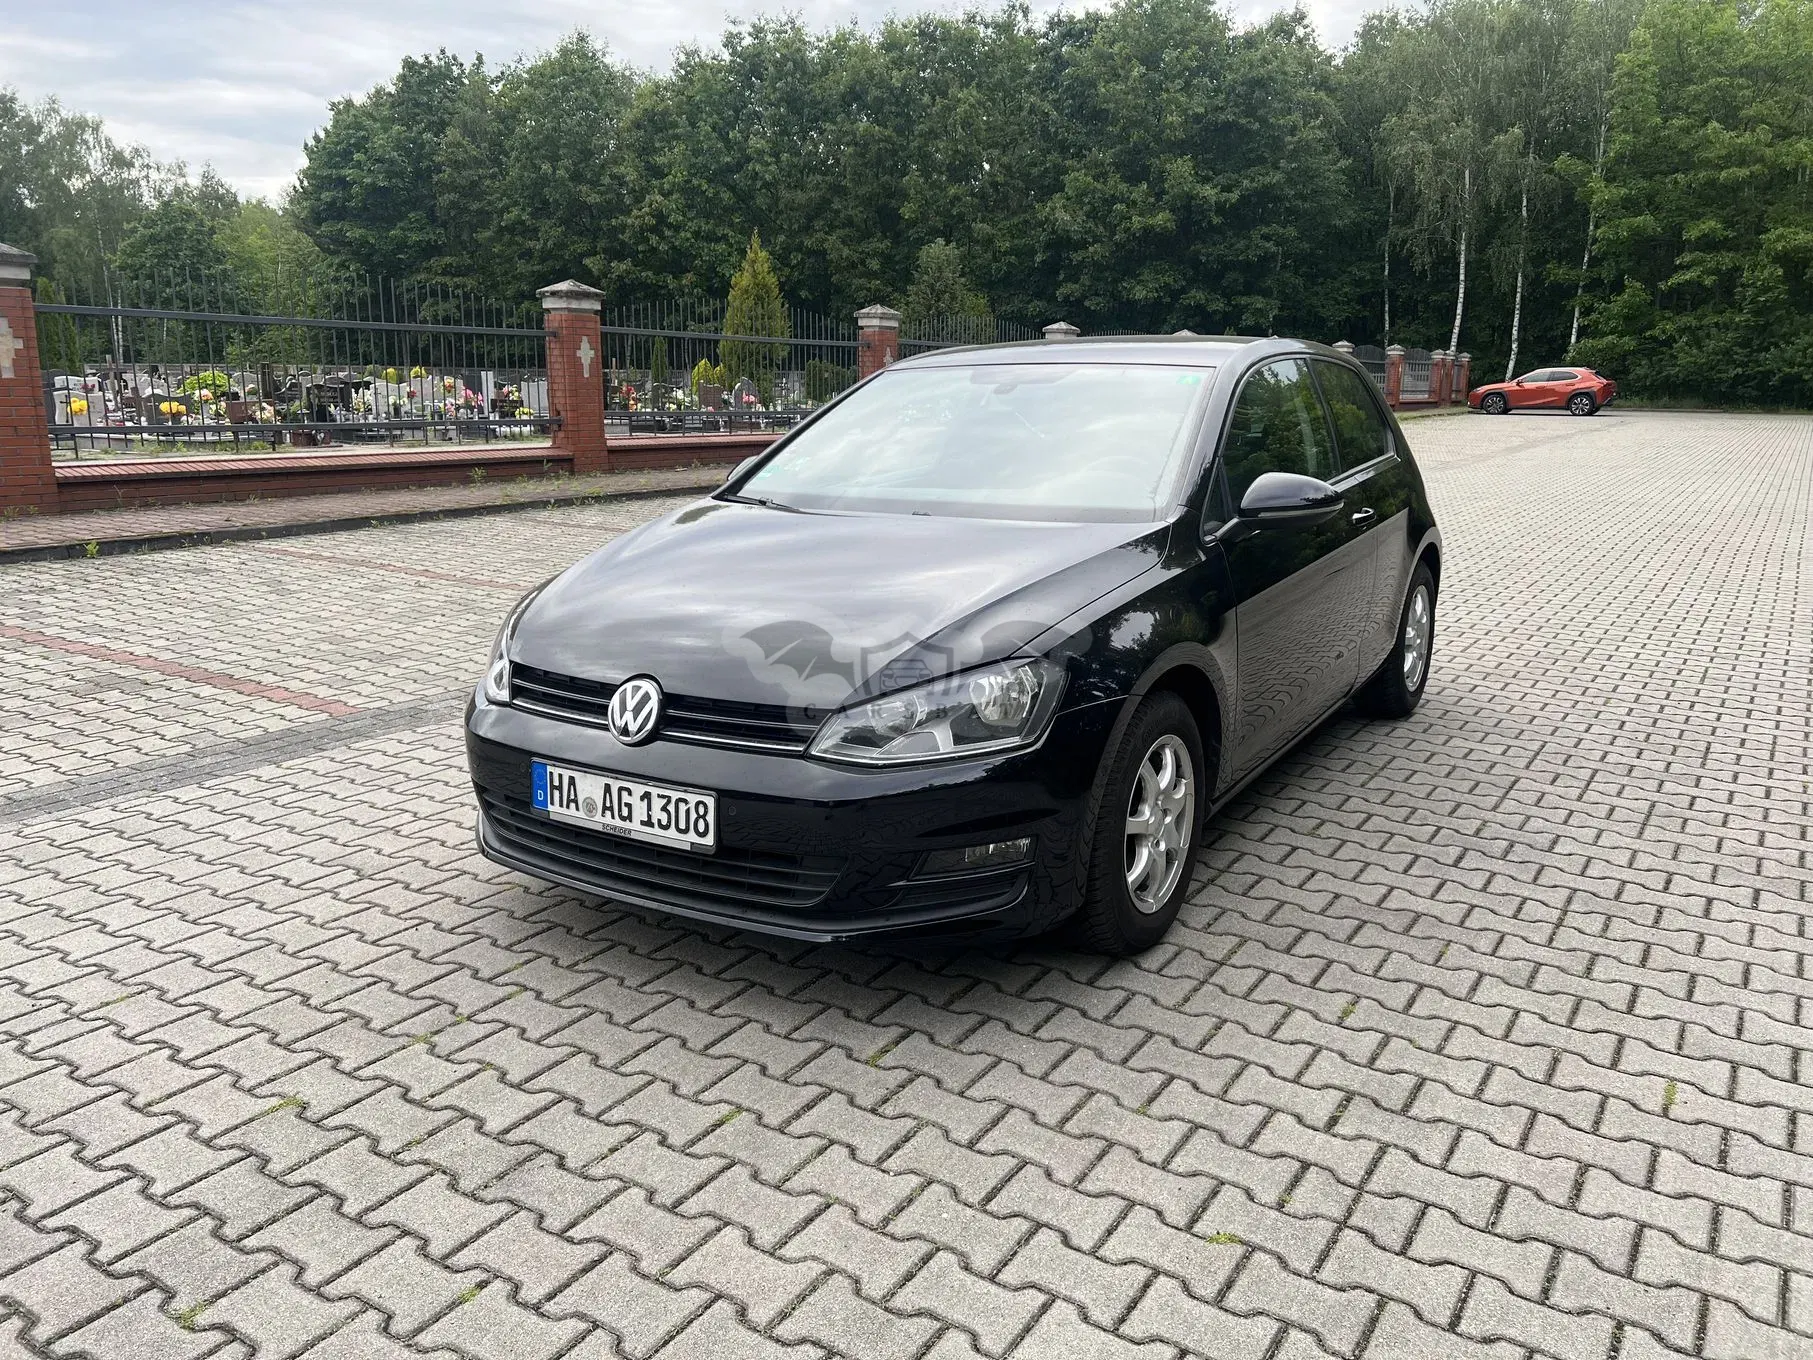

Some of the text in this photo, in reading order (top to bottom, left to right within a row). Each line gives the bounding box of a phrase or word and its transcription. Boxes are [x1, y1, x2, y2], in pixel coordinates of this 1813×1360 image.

[608, 679, 659, 743] VW
[537, 790, 544, 801] D
[549, 771, 709, 838] HA AG 1308
[601, 823, 632, 837] SCHEIDER
